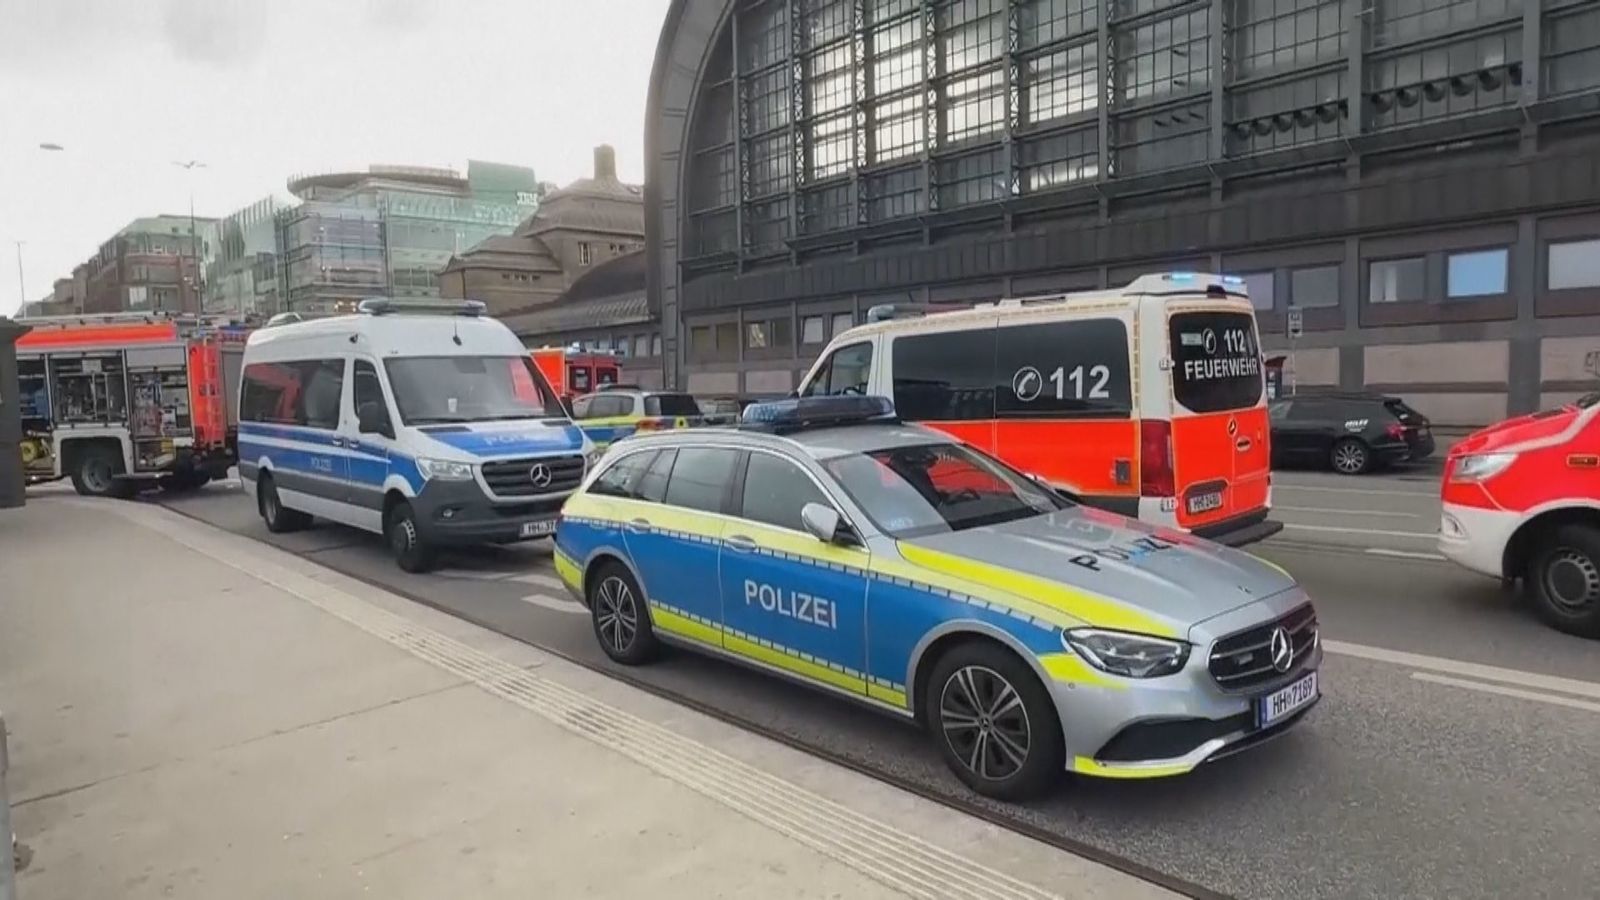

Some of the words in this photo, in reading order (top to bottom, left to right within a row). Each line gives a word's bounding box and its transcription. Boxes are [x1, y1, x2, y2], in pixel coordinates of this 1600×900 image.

[1224, 329, 1246, 353] 112
[1050, 364, 1110, 400] 112
[1184, 357, 1259, 380] FEUERWEHR
[744, 579, 837, 629] POLIZEI
